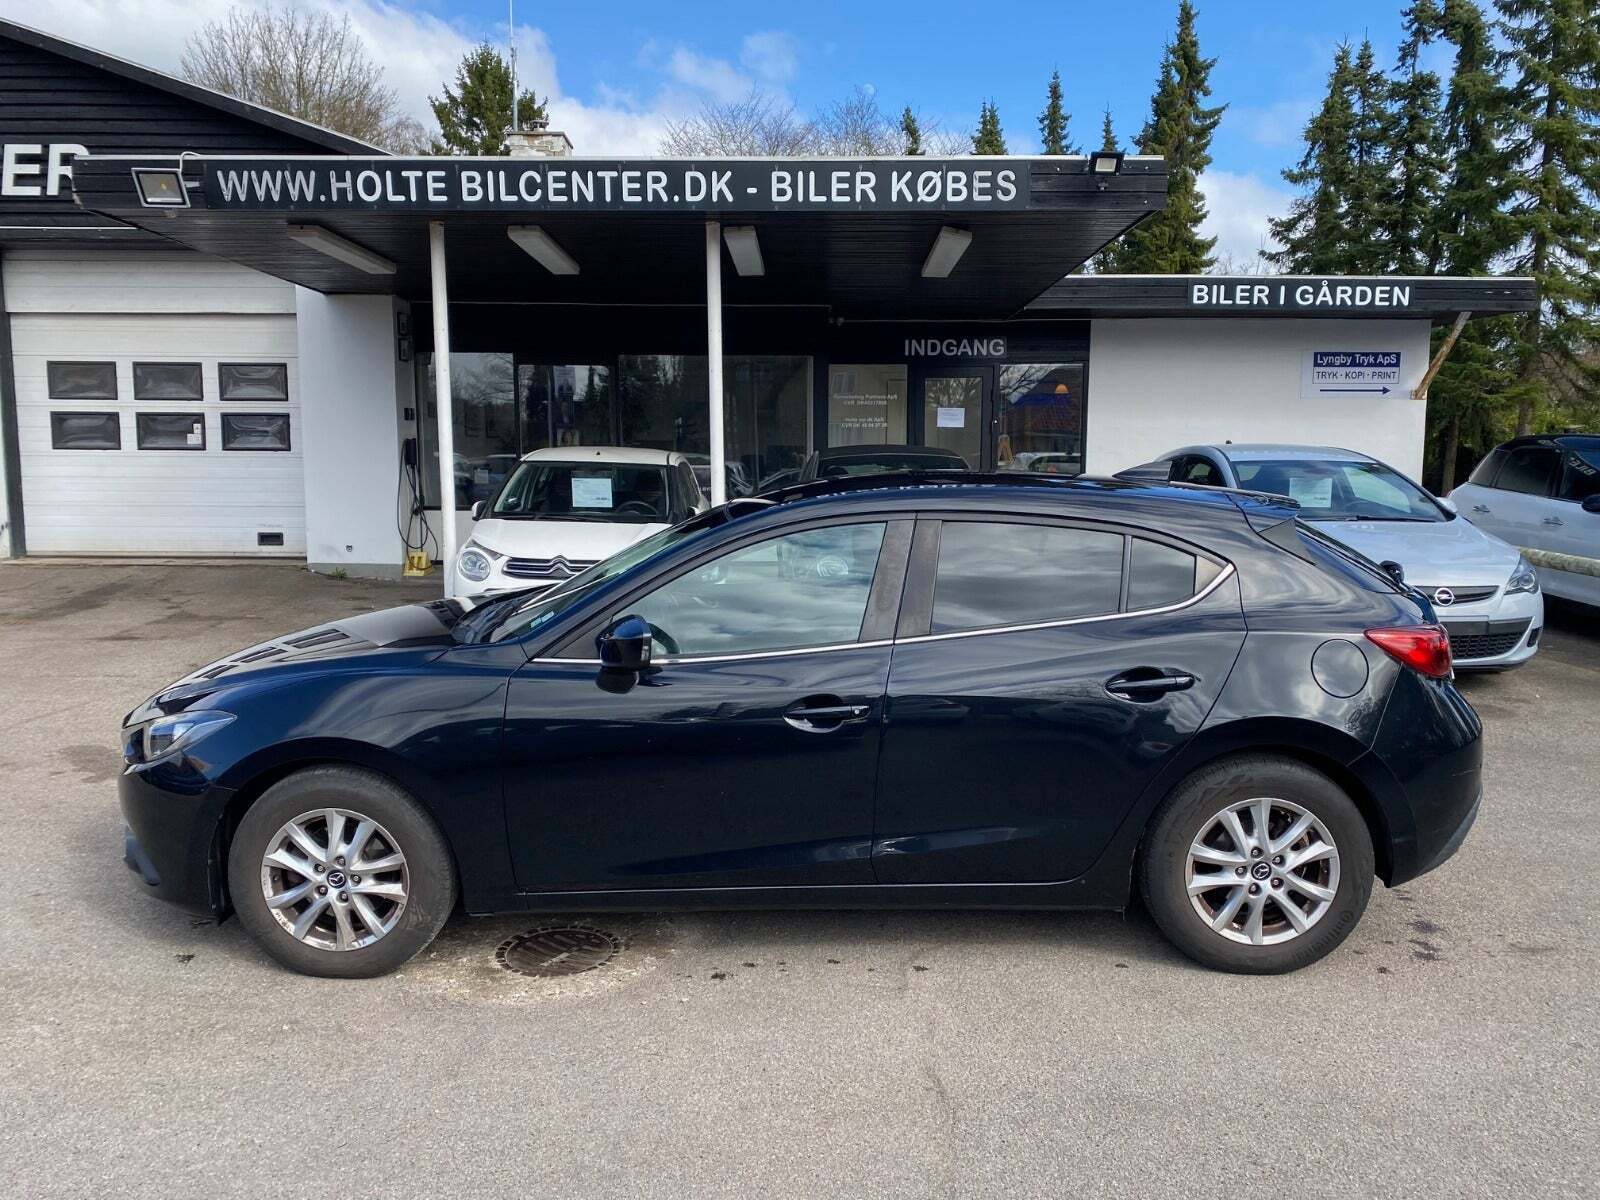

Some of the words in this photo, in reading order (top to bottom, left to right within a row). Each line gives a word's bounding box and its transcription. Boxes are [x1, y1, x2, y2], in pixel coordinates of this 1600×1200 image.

[216, 170, 448, 202] WWW.HOLTE
[460, 170, 734, 202] BILCENTER.DK
[771, 170, 877, 202] BILER
[891, 170, 1017, 202] KØBES
[1192, 284, 1270, 305] BILER
[1279, 285, 1286, 305] I
[1295, 280, 1410, 306] GÅRDEN
[904, 338, 1005, 356] INDGANG
[1317, 354, 1352, 366] Lyngby
[1354, 354, 1375, 366] Tryk
[1376, 354, 1397, 366] ApS
[1316, 371, 1339, 379] TRYK
[1371, 371, 1397, 379] PRINT
